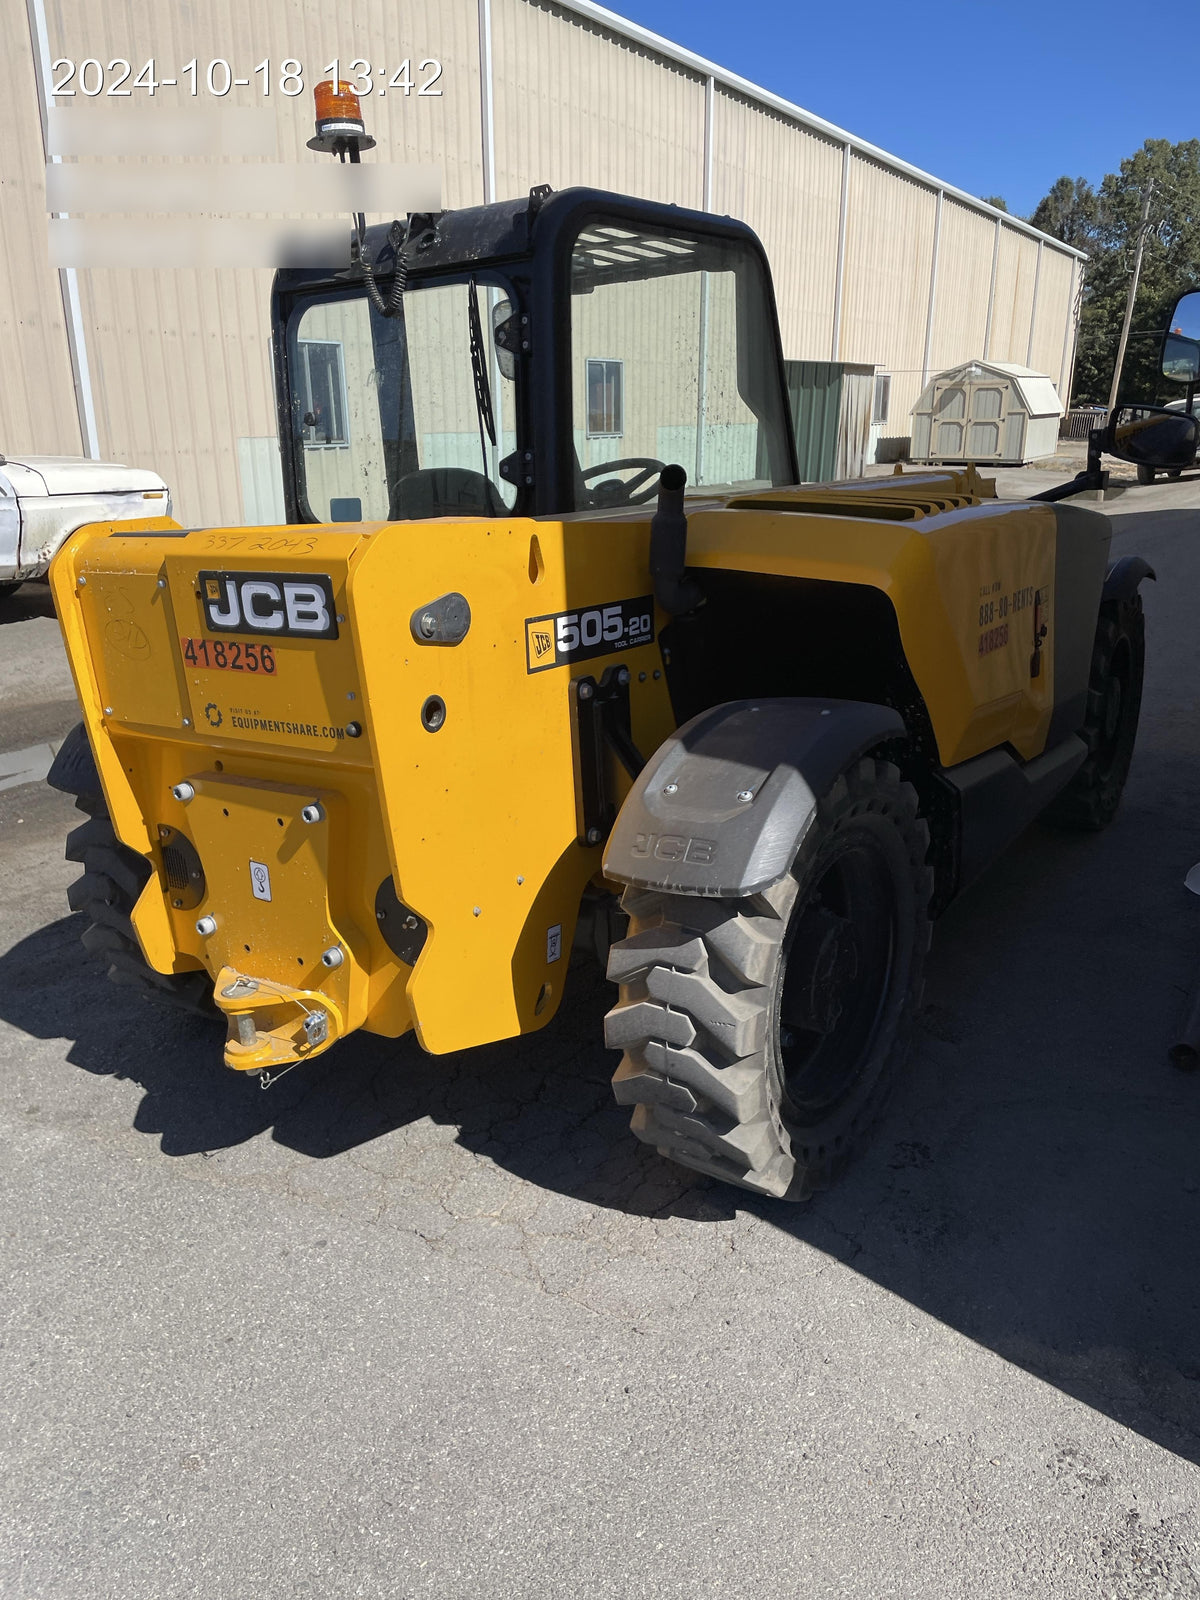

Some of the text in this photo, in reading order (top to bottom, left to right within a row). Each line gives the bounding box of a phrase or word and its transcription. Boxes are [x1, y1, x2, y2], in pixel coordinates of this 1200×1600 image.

[206, 535, 318, 555] 337 2043
[208, 580, 330, 631] JCB
[979, 586, 1034, 626] 888-80-RENTS
[535, 633, 551, 655] JCB
[556, 605, 651, 652] 505-20
[614, 641, 628, 649] TOOL
[184, 638, 275, 673] 418256
[231, 716, 345, 740] EQUIPMENTSHARE.COM
[630, 832, 718, 867] JCB
